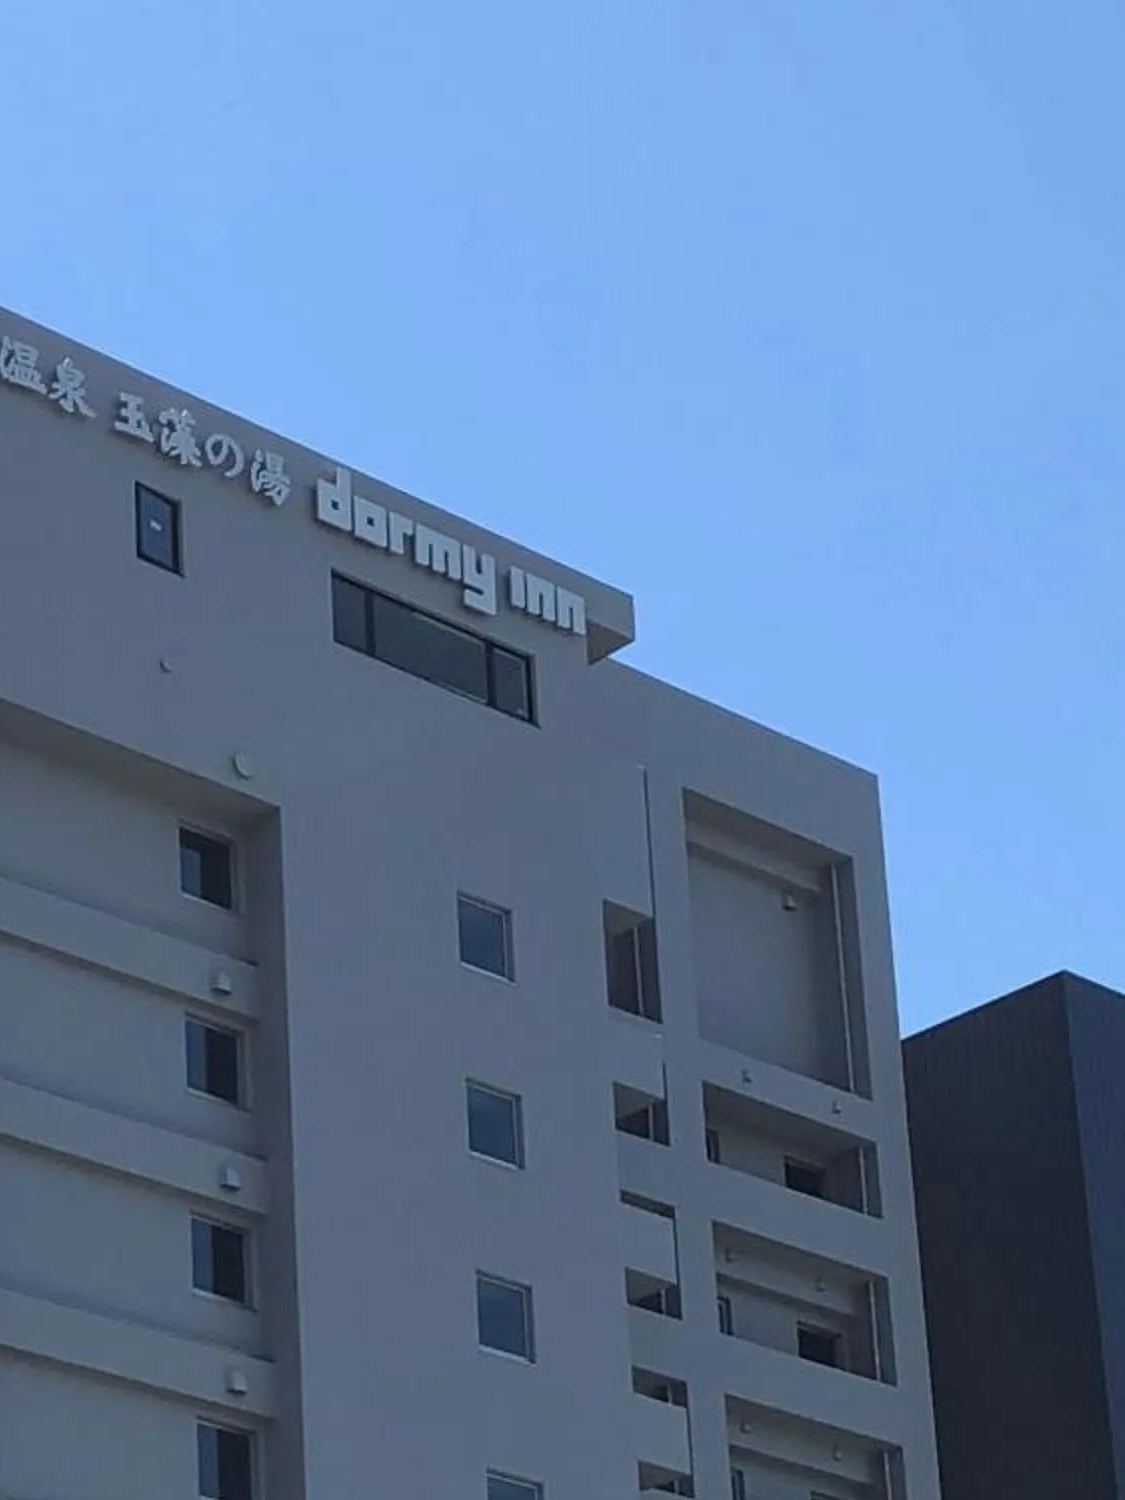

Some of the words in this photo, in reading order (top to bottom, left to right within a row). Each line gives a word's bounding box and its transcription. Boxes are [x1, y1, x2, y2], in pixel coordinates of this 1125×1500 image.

[114, 391, 292, 507] 玉藻の湯
[315, 466, 499, 617] dormy
[509, 564, 588, 637] inn
